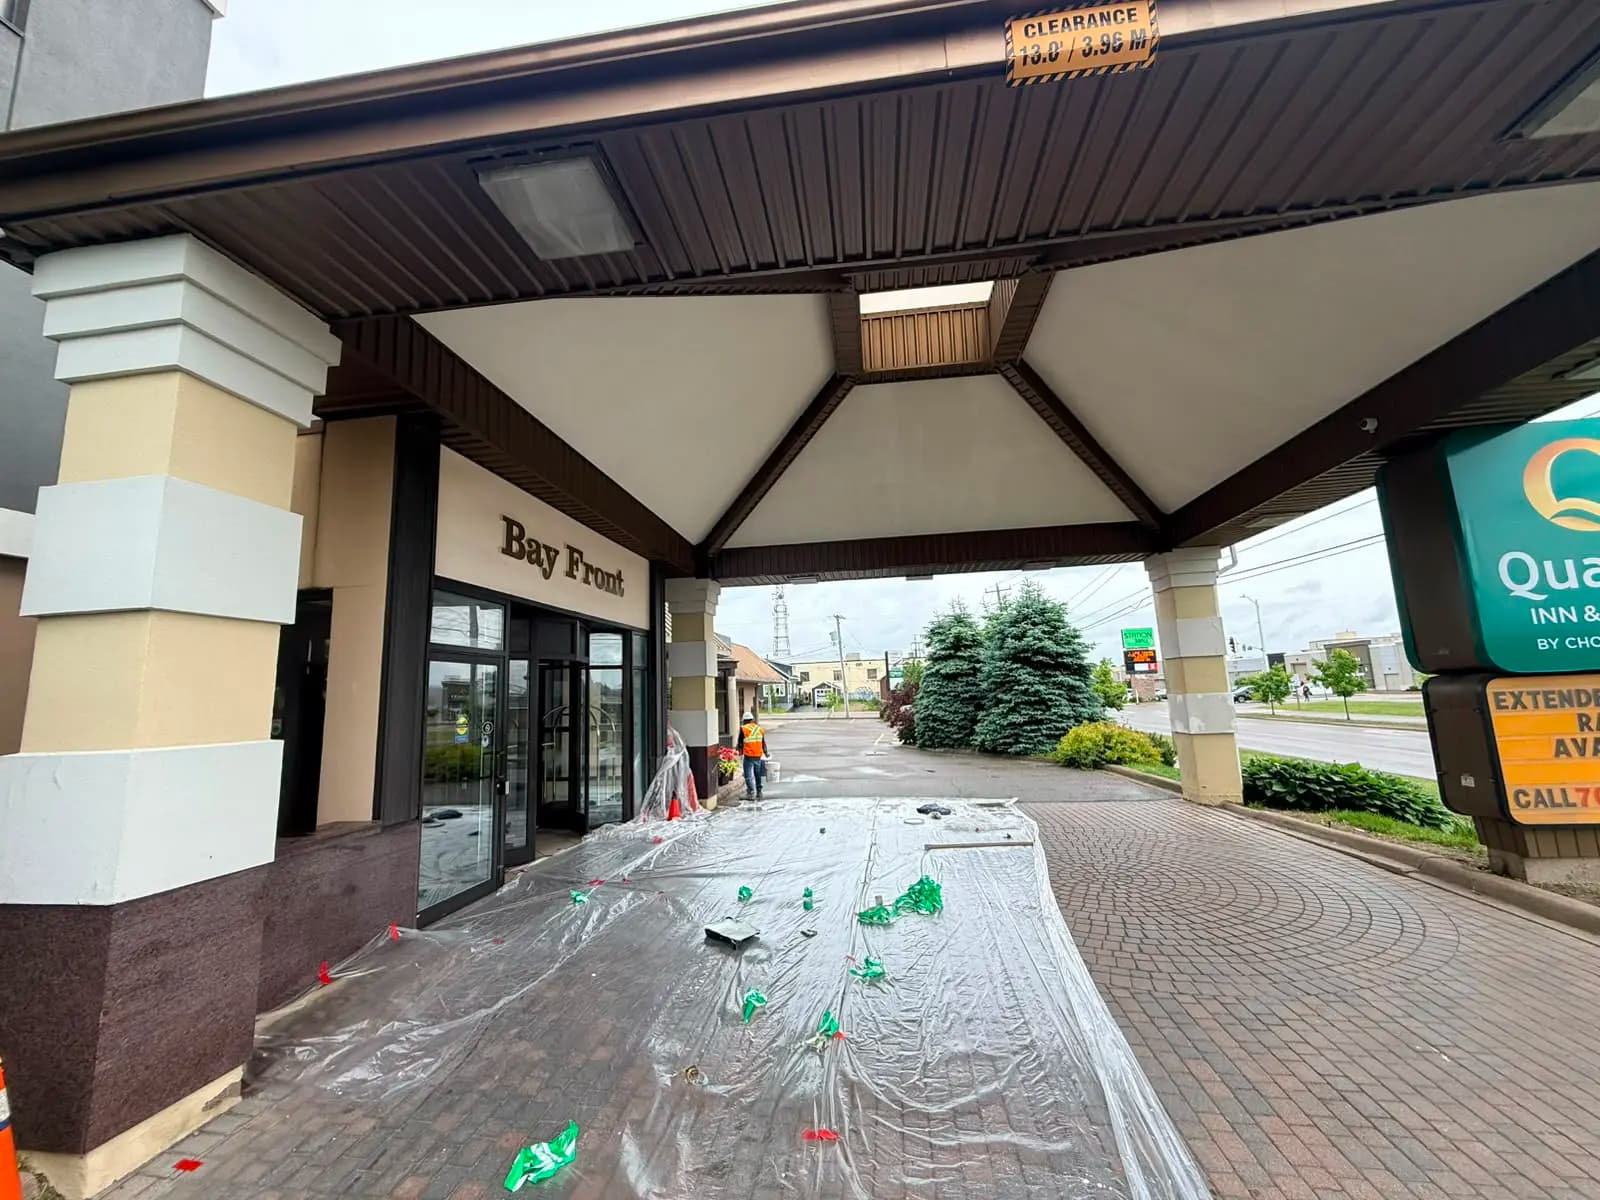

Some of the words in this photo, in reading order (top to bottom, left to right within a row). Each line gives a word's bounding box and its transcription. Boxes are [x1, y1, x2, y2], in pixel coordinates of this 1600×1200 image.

[1024, 7, 1138, 39] CLEARANCE
[1082, 31, 1123, 58] 3.96
[1129, 27, 1148, 51] M
[499, 513, 560, 580] Bay
[564, 542, 625, 598] Front
[1530, 606, 1578, 625] INN
[1583, 605, 1600, 622] &
[1537, 638, 1559, 650] BY
[1513, 787, 1577, 809] CALL
